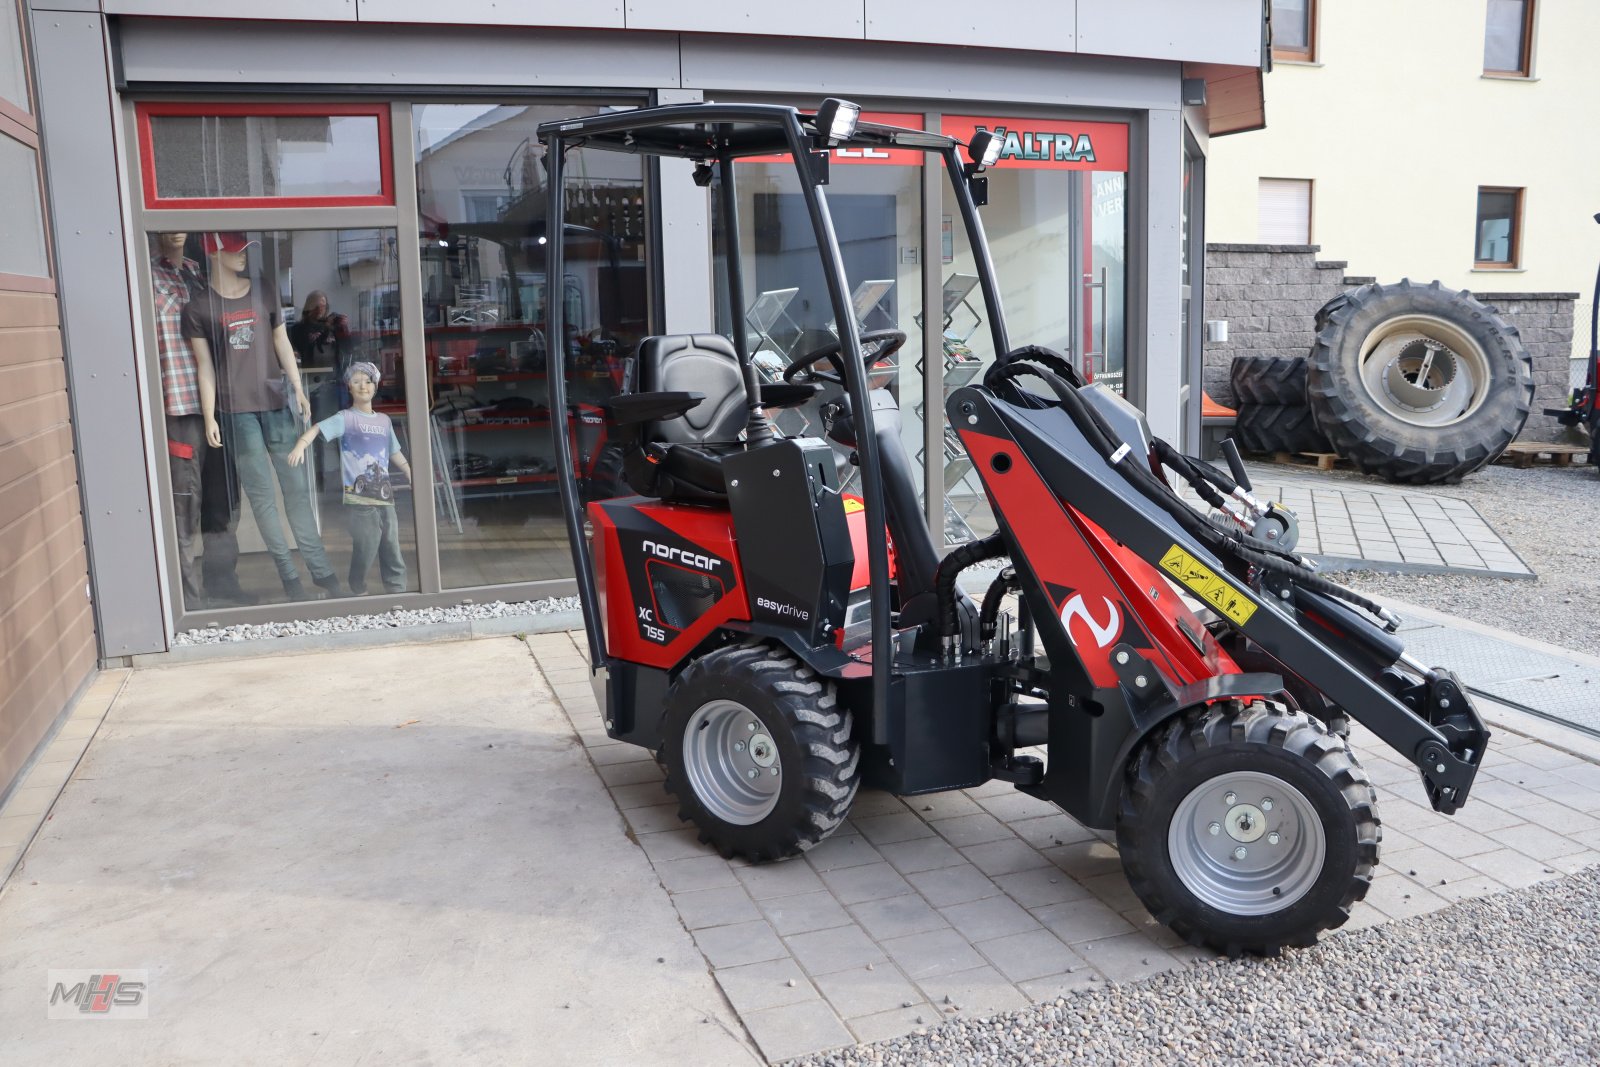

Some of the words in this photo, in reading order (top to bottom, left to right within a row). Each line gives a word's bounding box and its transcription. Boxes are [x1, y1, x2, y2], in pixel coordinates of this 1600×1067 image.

[642, 540, 721, 571] norcar
[638, 606, 653, 622] XC
[756, 597, 809, 620] easydrive
[642, 623, 666, 642] 755
